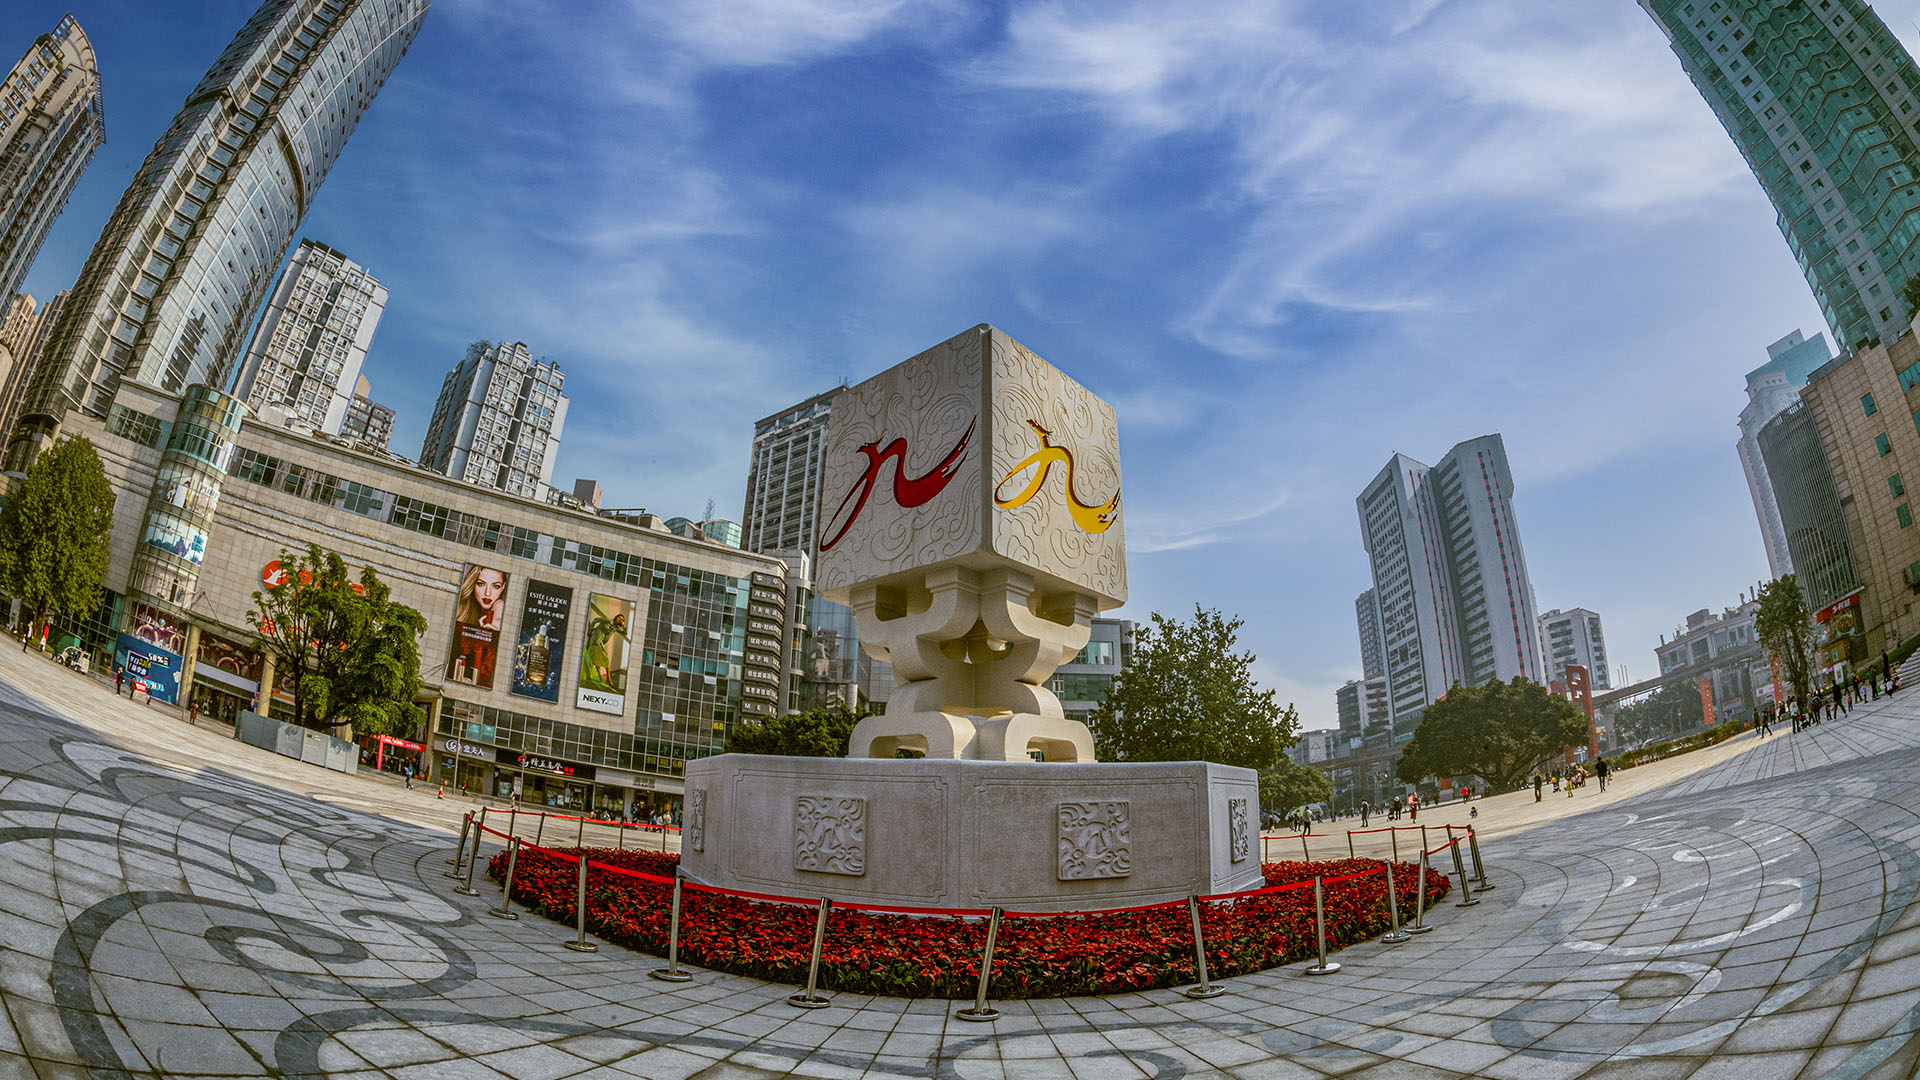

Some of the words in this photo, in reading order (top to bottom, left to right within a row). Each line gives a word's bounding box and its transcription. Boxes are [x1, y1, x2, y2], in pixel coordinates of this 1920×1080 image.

[545, 595, 568, 606] LAUDER
[582, 693, 619, 707] NEXY.CO
[713, 721, 724, 730] 68
